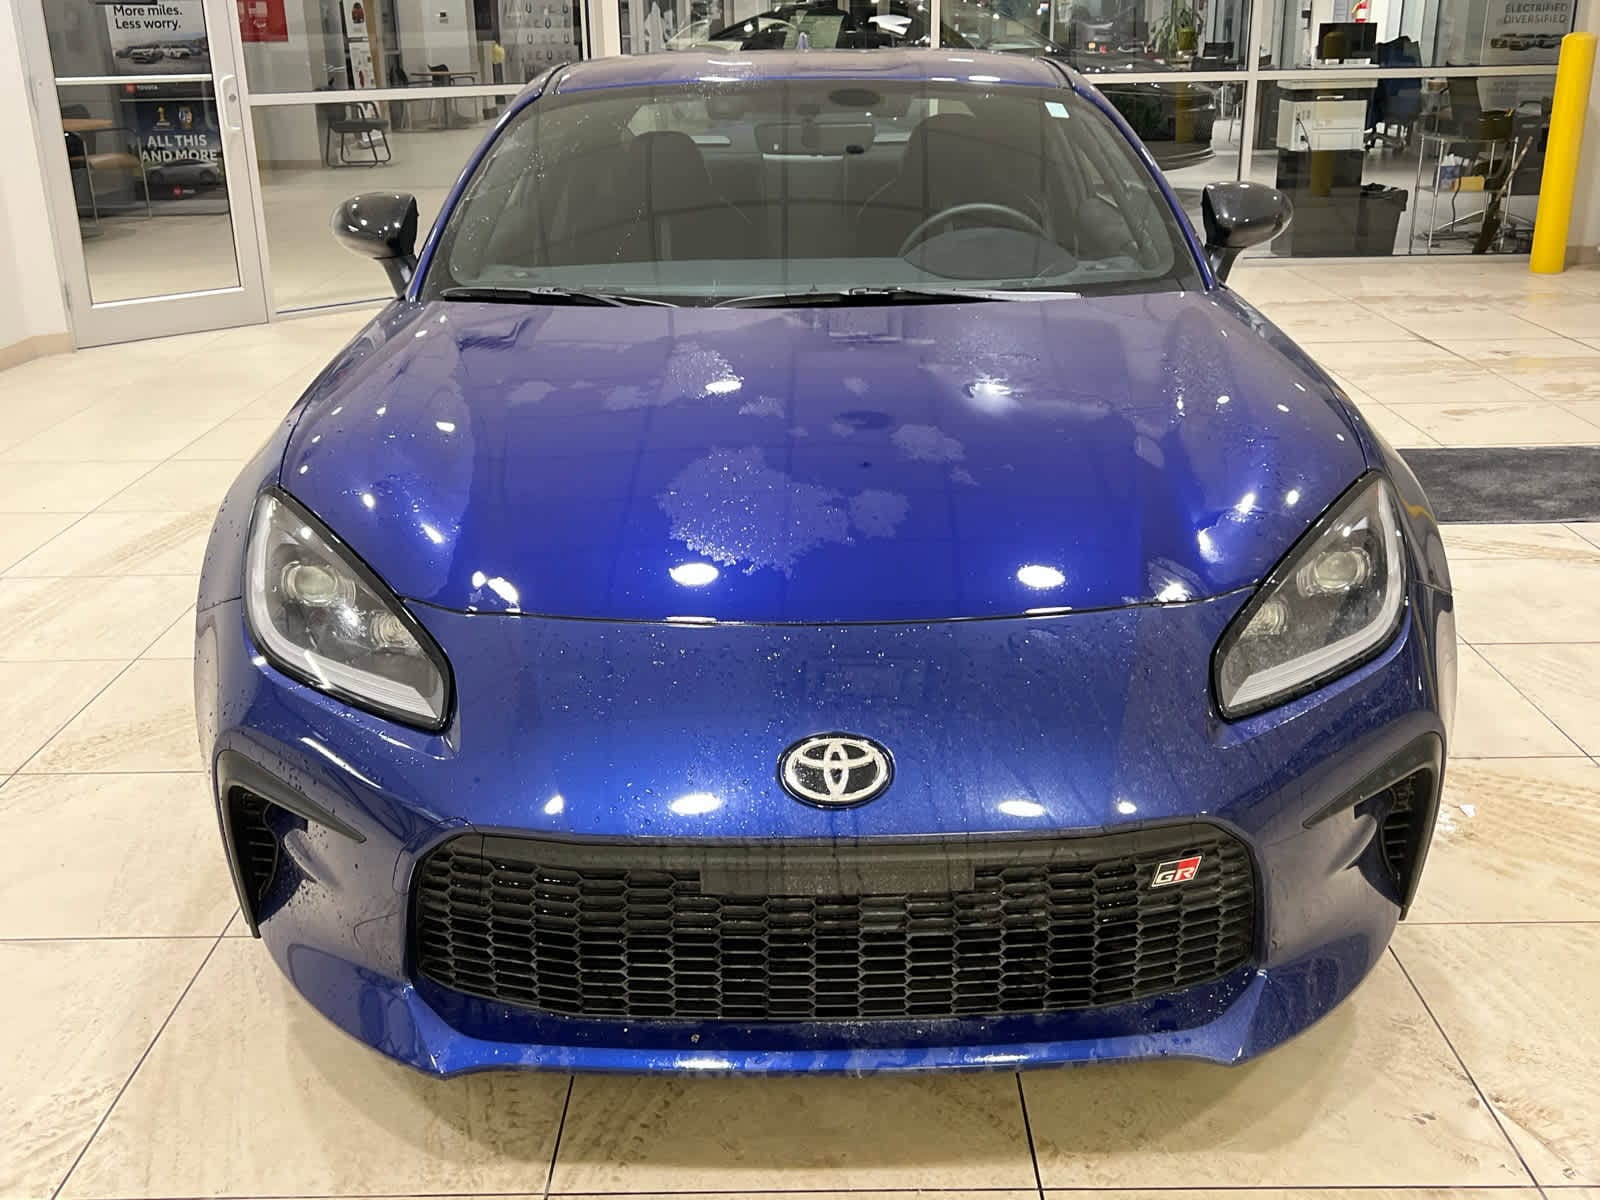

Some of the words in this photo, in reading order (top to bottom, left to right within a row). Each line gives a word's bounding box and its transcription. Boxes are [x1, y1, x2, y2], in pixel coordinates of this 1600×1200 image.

[113, 5, 144, 16] More
[147, 5, 183, 16] miles.
[1505, 2, 1568, 14] ELECTRIFIED
[115, 18, 141, 29] Less
[144, 19, 181, 31] worry.
[147, 135, 173, 148] ALL
[174, 134, 208, 147] THIS
[142, 149, 173, 162] AND
[175, 148, 218, 161] MORE
[1155, 867, 1195, 884] GR
